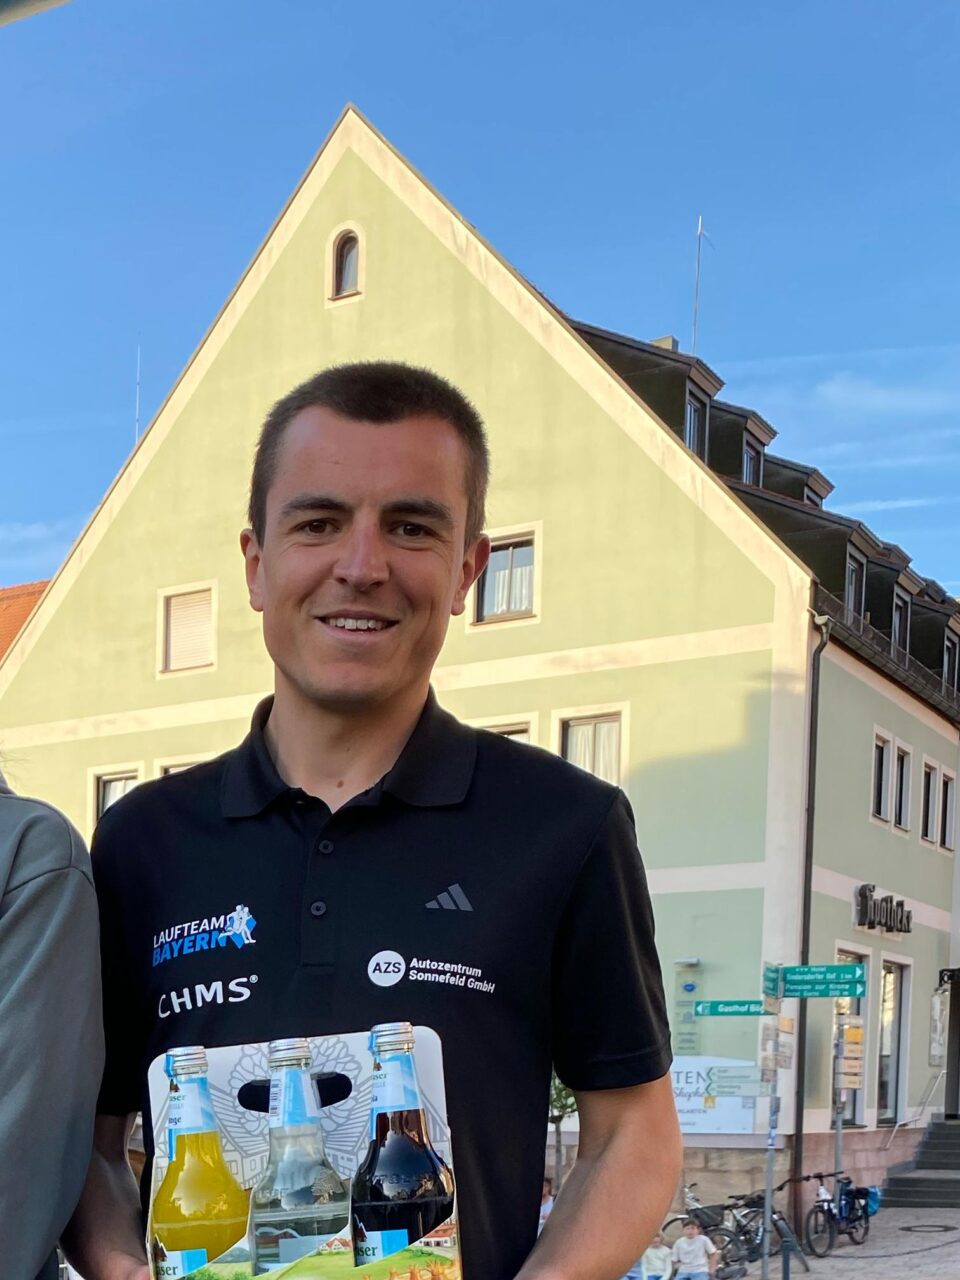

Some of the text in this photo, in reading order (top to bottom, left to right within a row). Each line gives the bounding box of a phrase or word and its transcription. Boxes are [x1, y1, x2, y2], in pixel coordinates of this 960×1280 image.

[153, 914, 226, 948] LAUFTEAM
[152, 928, 229, 967] BAYERN
[372, 961, 402, 975] AZS
[409, 957, 482, 977] Autozentrum
[409, 969, 496, 994] Sonnefeld GmbH
[718, 1003, 748, 1013] Gasthof
